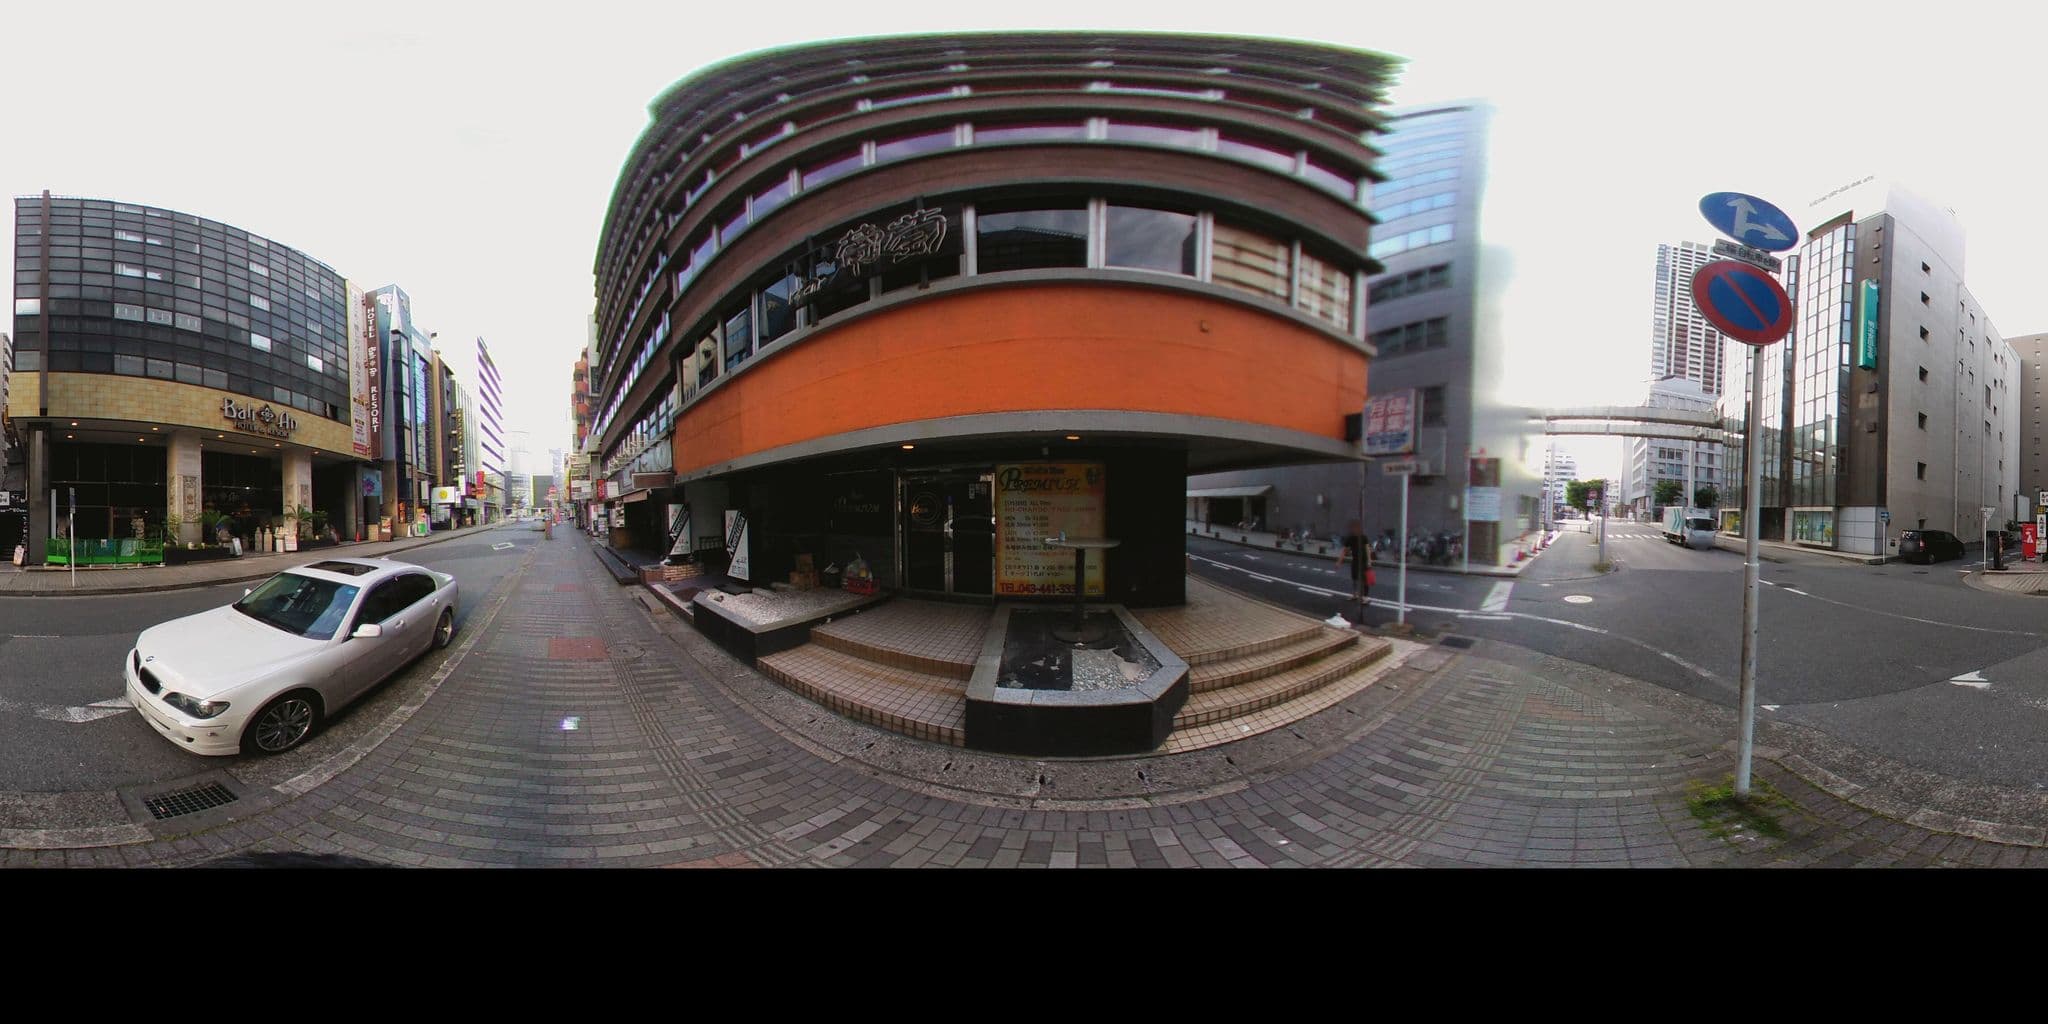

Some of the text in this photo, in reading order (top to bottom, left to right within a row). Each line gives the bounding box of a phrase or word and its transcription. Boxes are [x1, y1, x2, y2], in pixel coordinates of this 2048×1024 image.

[367, 307, 375, 338] HOTEL
[221, 397, 299, 431] Bali An
[370, 386, 379, 433] RESORT
